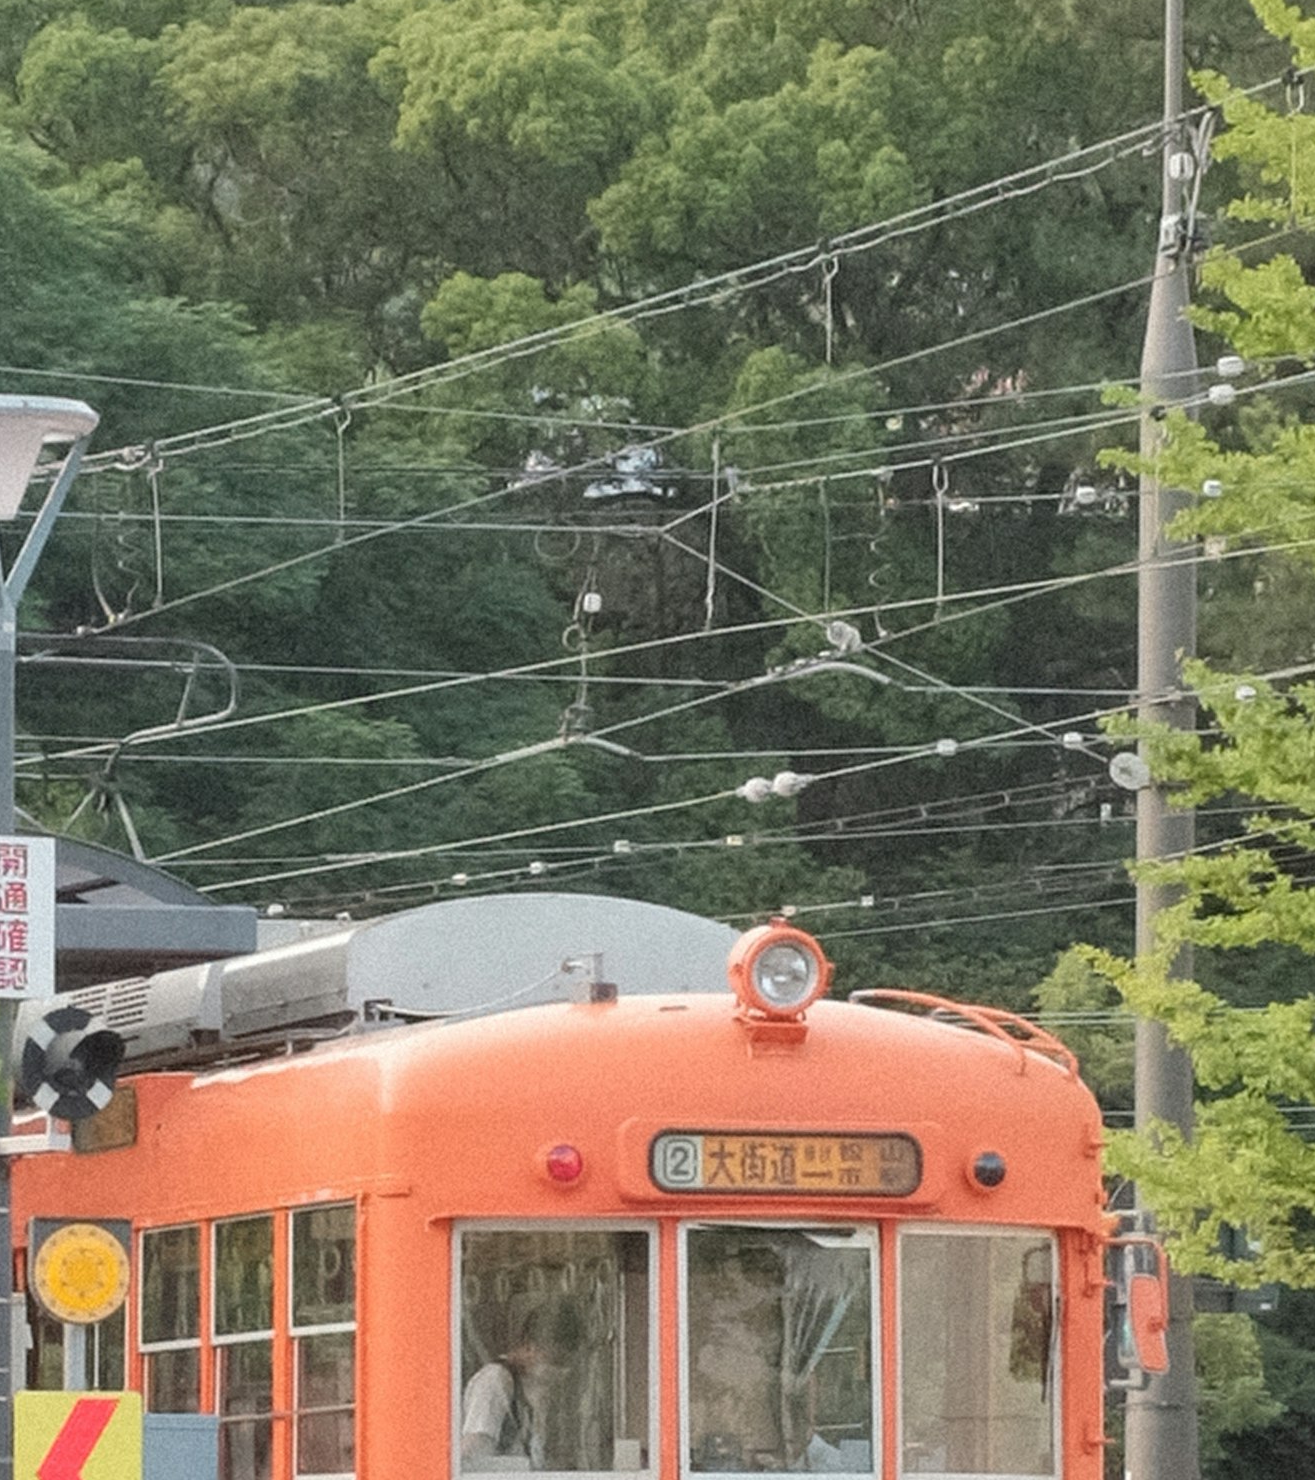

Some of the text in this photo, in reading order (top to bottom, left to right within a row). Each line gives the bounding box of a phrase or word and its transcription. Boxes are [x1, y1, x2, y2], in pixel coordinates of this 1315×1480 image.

[669, 1146, 690, 1177] 2
[708, 1142, 797, 1185] 大街道
